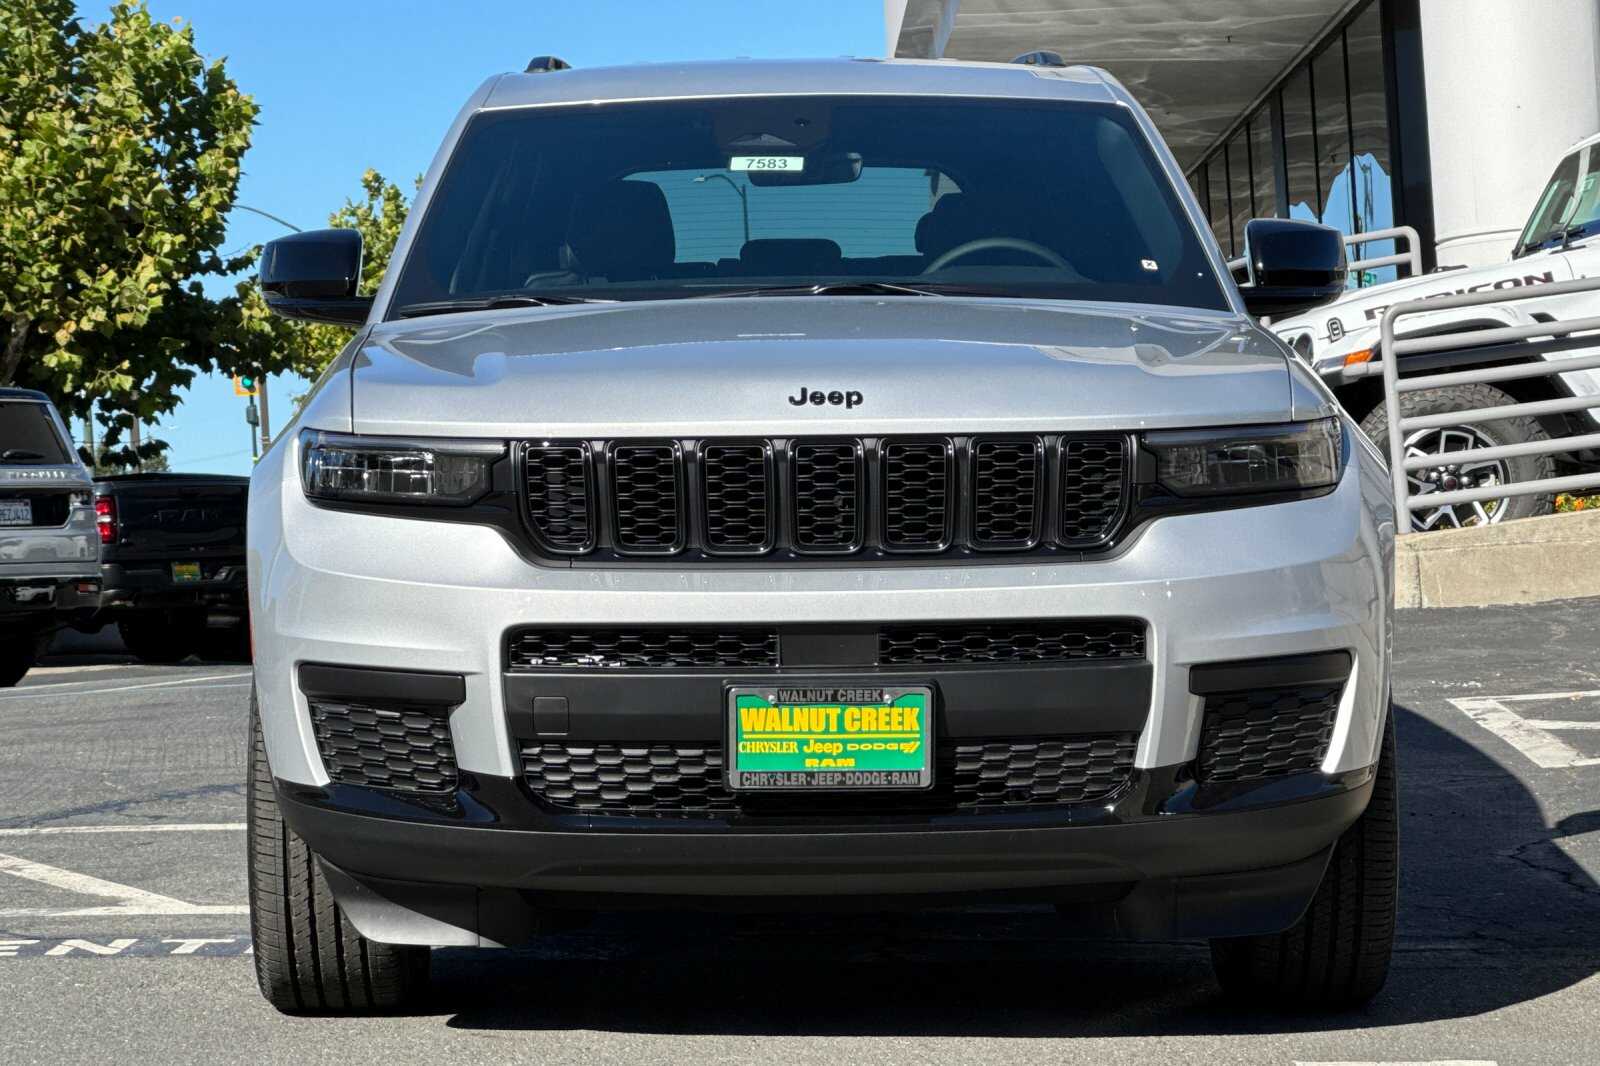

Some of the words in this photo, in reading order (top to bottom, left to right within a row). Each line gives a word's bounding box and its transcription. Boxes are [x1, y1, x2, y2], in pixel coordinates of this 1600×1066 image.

[745, 158, 788, 169] 7583
[788, 387, 864, 409] Jeep
[778, 689, 834, 702] WALNUT
[837, 689, 881, 702] CREEK
[740, 707, 840, 732] WALNUT
[844, 707, 919, 732] CREEK
[738, 741, 799, 753] CHRYSLER
[803, 739, 843, 755] Jeep
[805, 758, 855, 767] RAM
